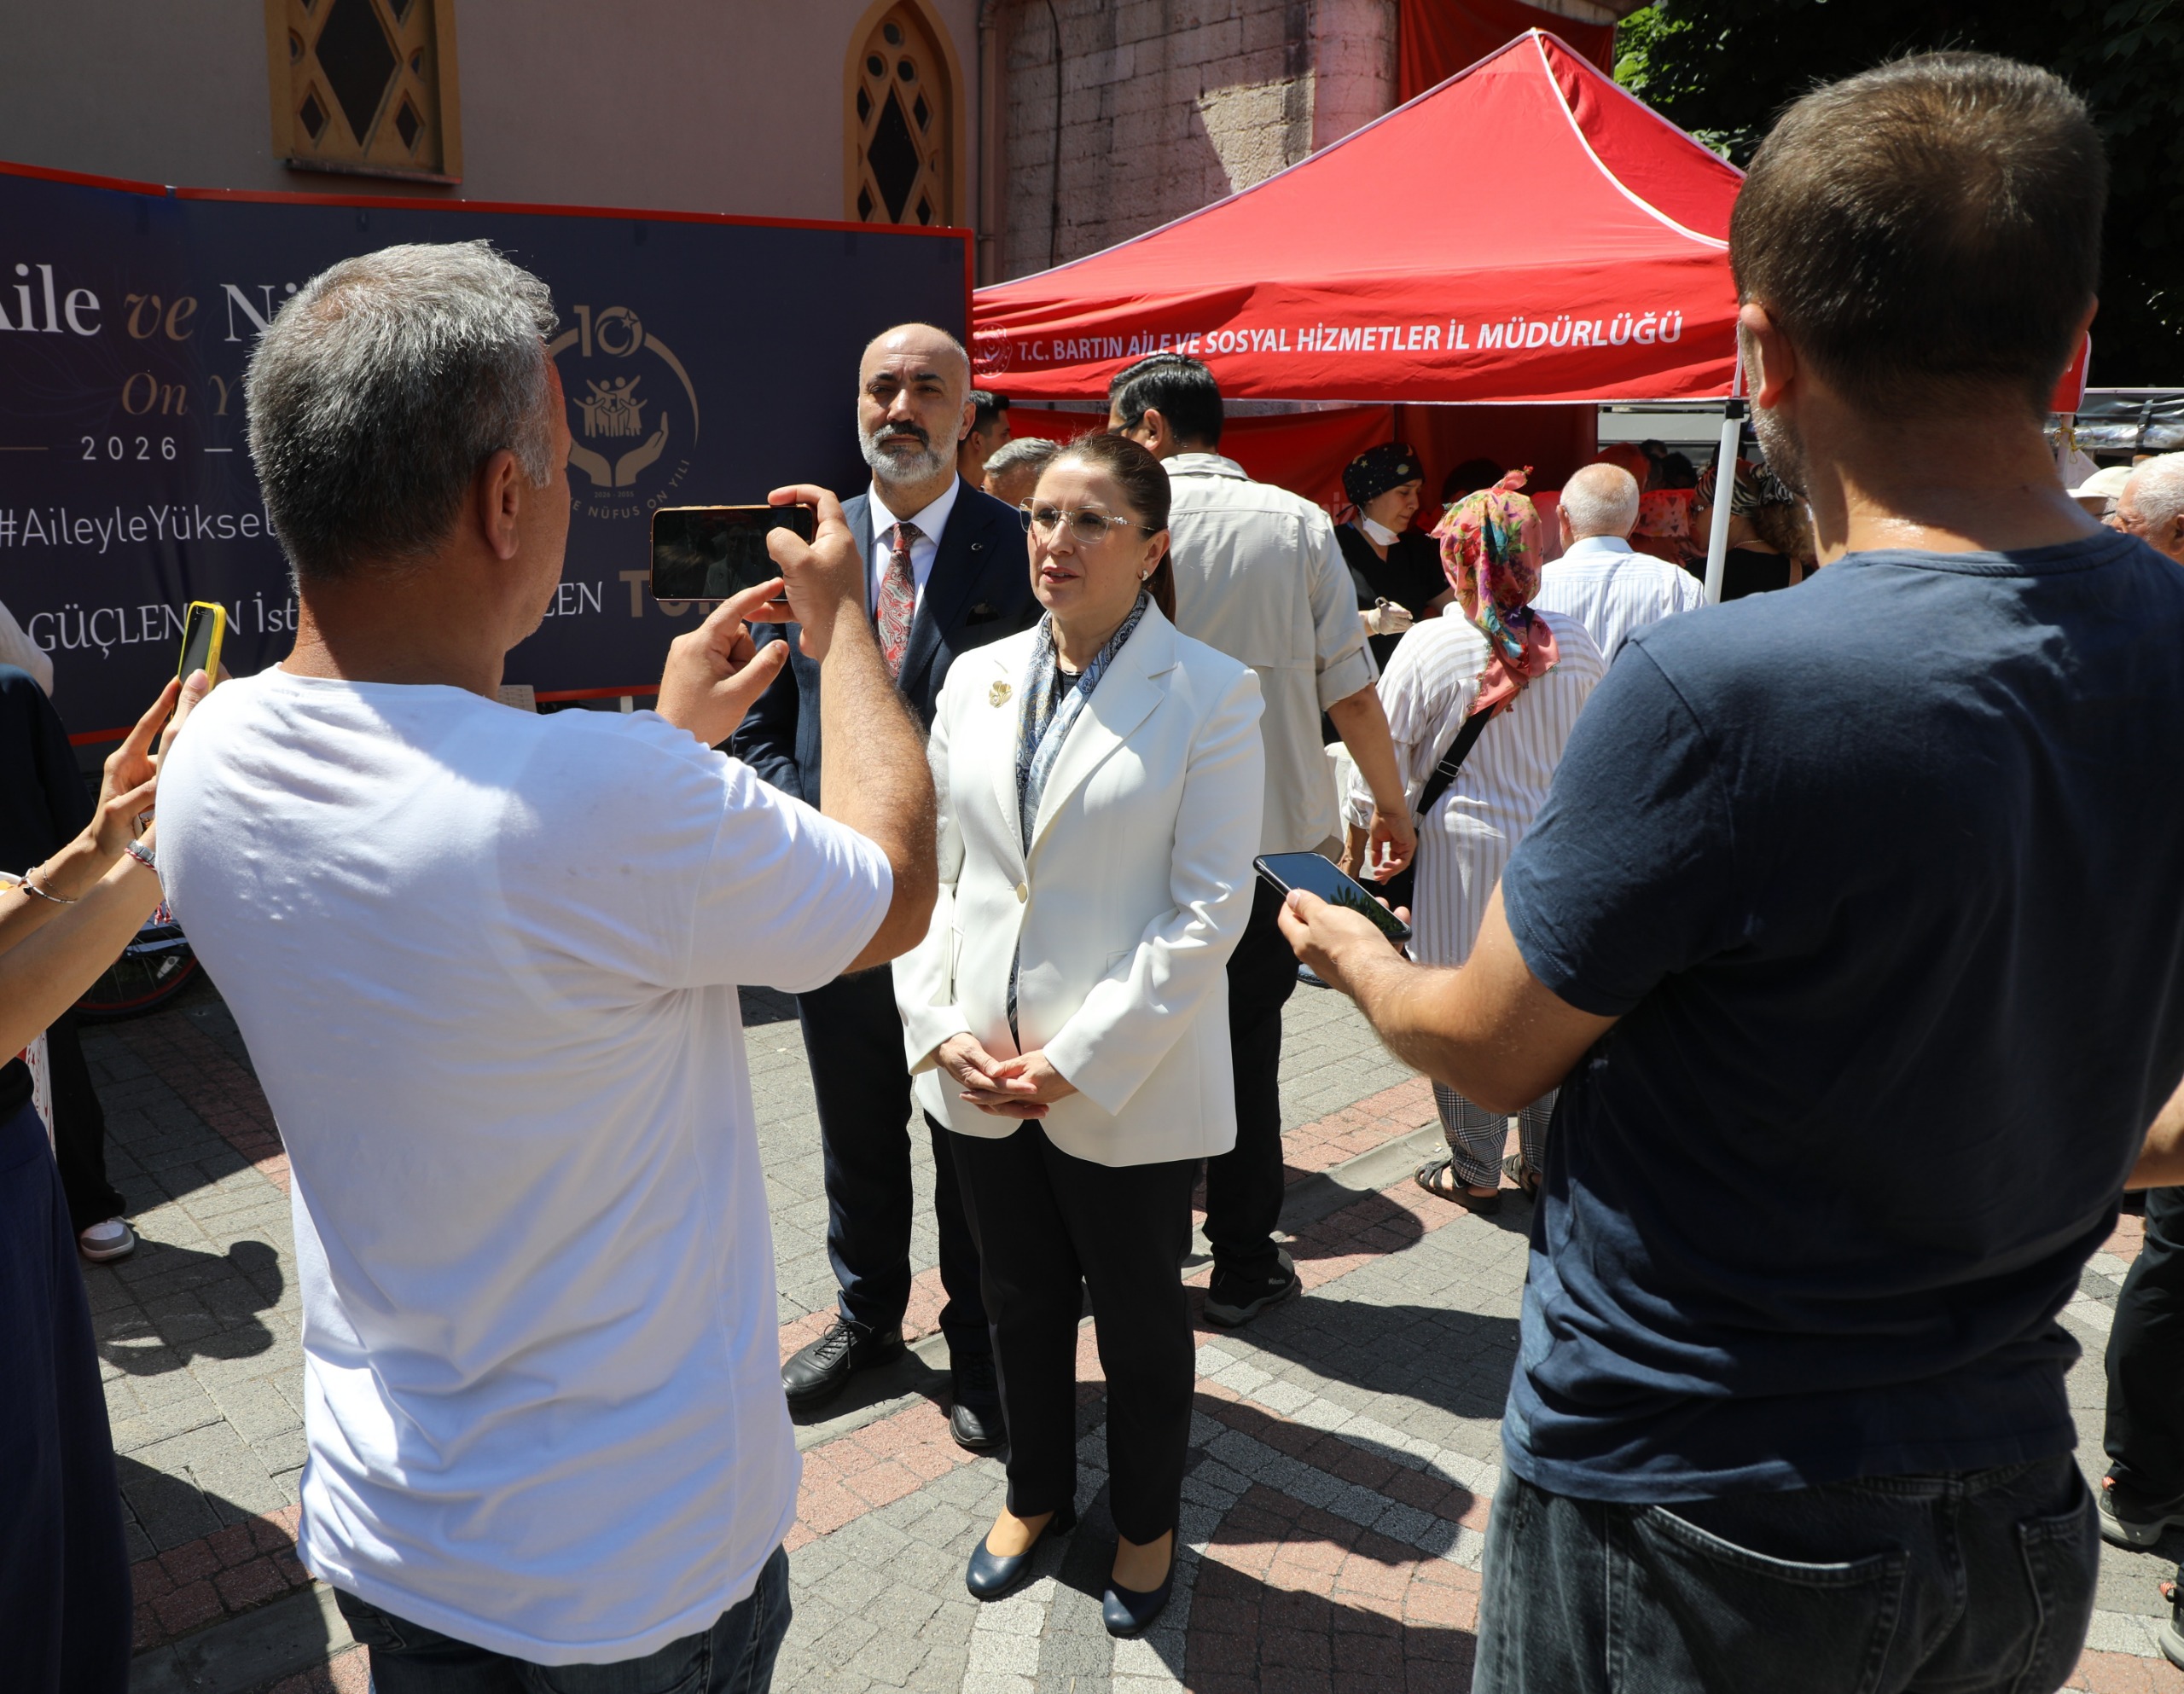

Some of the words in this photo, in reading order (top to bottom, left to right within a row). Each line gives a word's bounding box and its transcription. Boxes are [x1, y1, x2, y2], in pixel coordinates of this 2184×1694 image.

[125, 293, 197, 341] ve
[573, 305, 643, 358] 10
[1018, 340, 1048, 361] T.C.
[1054, 336, 1121, 360] BARTIN
[1126, 330, 1171, 357] AİLE
[1175, 332, 1202, 355] VE
[1205, 328, 1291, 353] SOSYAL
[1297, 322, 1442, 351] HİZMETLER
[1447, 319, 1470, 350] İL
[1477, 310, 1682, 349] MÜDÜRLÜĞÜ
[122, 373, 187, 415] On
[81, 436, 177, 461] 2026
[588, 505, 640, 519] NÜFUS
[646, 490, 668, 509] ON
[668, 459, 690, 488] YILI
[0, 504, 275, 554] #AileyleYüksel
[29, 601, 241, 659] GÜÇLENN
[253, 591, 297, 633] İst
[543, 581, 603, 617] EN
